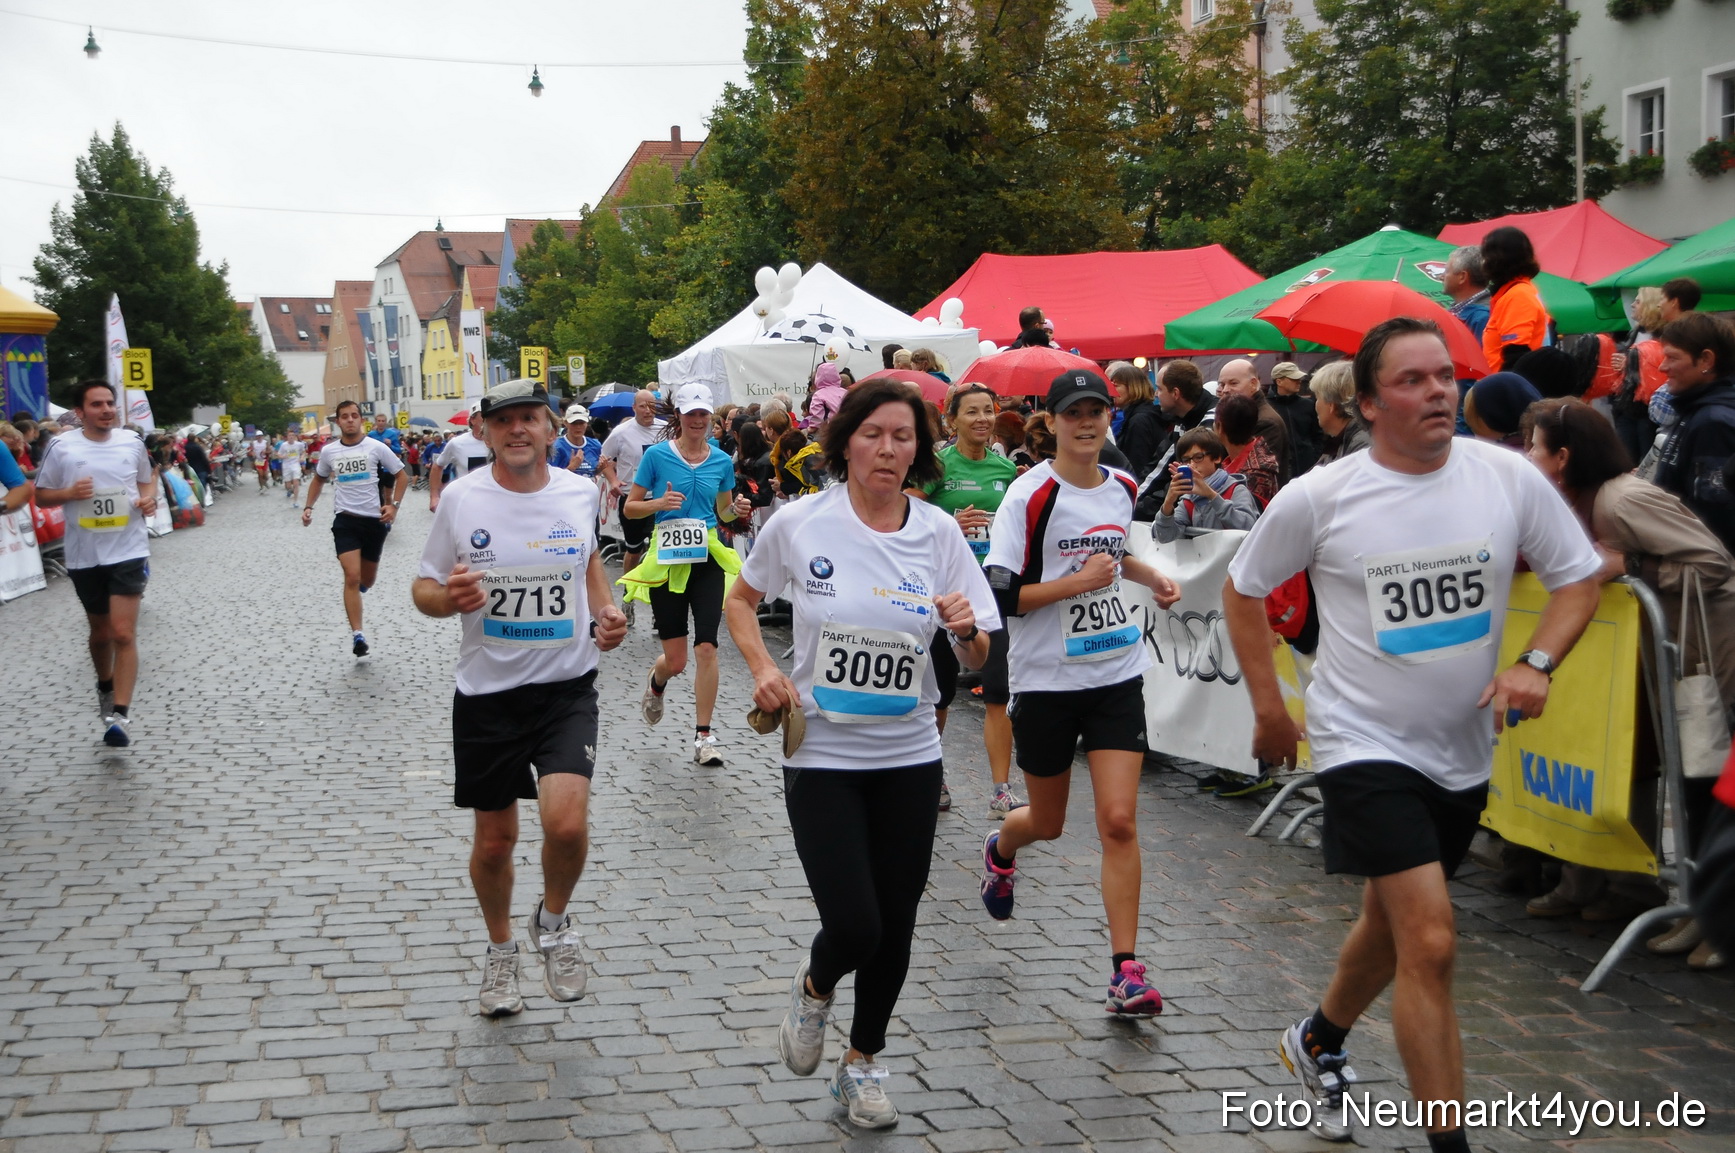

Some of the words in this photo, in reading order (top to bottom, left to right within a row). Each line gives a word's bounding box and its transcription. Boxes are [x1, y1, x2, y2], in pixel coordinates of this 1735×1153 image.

[125, 350, 148, 358] Block
[524, 348, 545, 356] Block
[130, 362, 144, 381] B
[528, 359, 541, 378] B
[746, 382, 790, 396] Kinder
[400, 416, 407, 425] C
[338, 459, 367, 474] 2495
[93, 499, 114, 516] 30
[662, 528, 703, 547] 2899
[1058, 536, 1123, 550] GERHART
[470, 549, 496, 559] PARTL
[471, 556, 497, 564] Neumarkt
[672, 549, 692, 557] Maria
[1367, 563, 1409, 578] PARTL
[1412, 554, 1472, 572] Neumarkt
[482, 574, 513, 584] PARTL
[515, 573, 558, 583] Neumarkt
[806, 579, 836, 592] PARTL
[806, 588, 836, 598] Neumarkt
[1090, 586, 1113, 597] Neumarkt
[1381, 569, 1484, 623] 3065
[490, 585, 566, 618] 2713
[1070, 596, 1127, 634] 2920
[502, 625, 555, 637] Klemens
[822, 630, 858, 645] PARTL
[861, 636, 911, 651] Neumarkt
[1084, 634, 1129, 652] Christine
[825, 647, 915, 691] 3096
[1519, 748, 1595, 816] KANN
